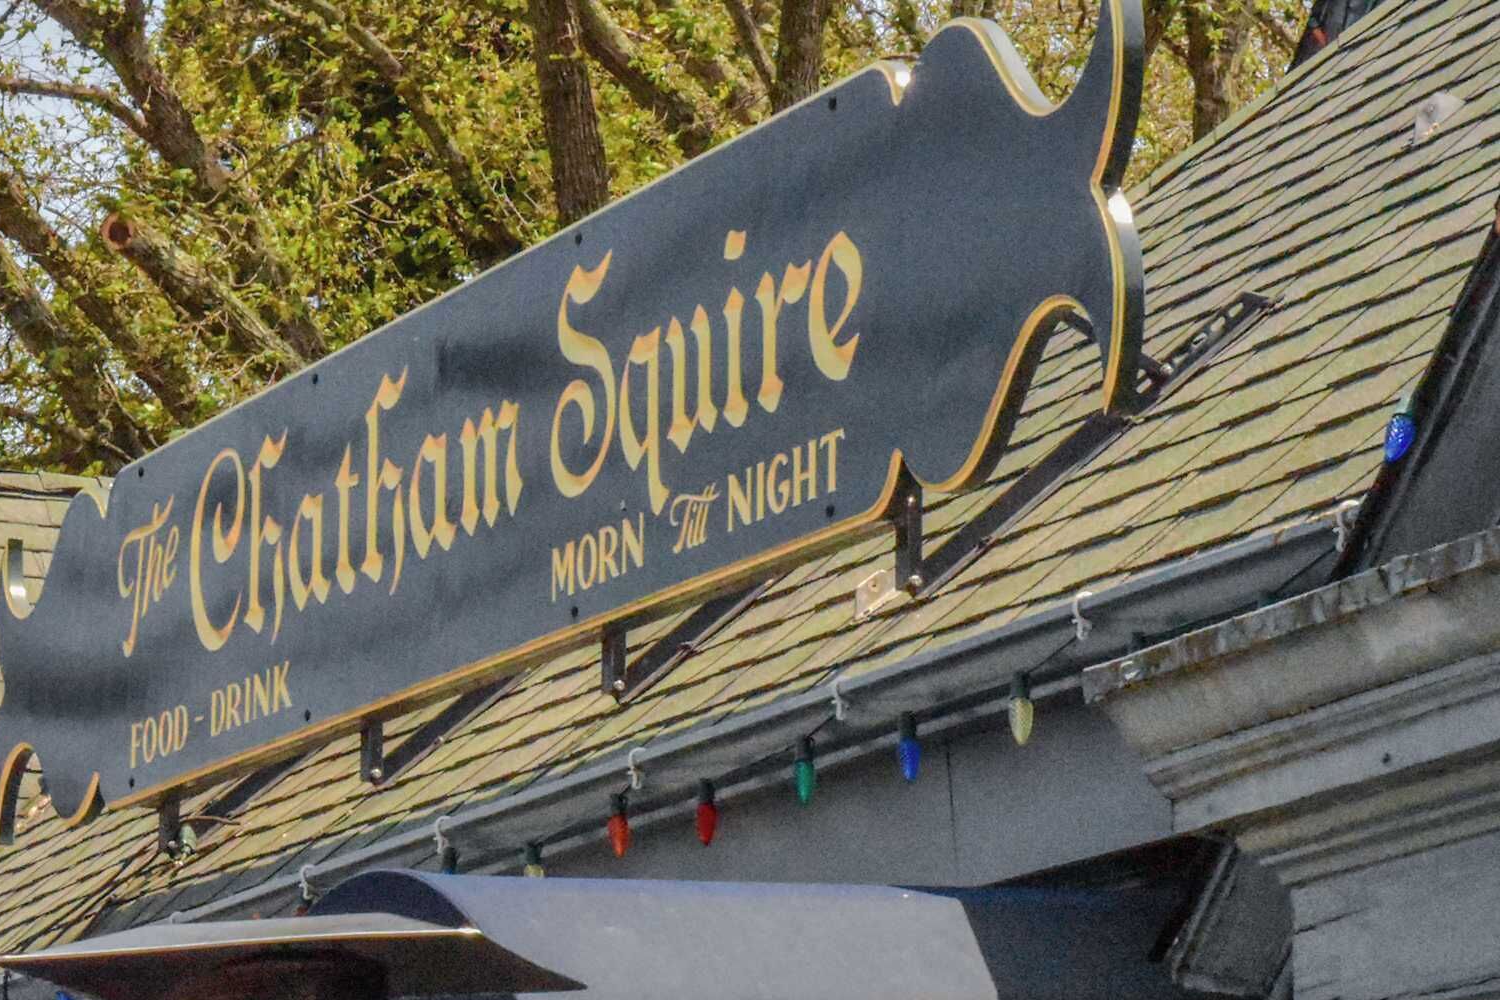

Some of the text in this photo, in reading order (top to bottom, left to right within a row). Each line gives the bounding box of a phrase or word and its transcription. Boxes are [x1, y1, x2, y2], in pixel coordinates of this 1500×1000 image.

[117, 230, 863, 658] The Chatham Squire
[551, 512, 644, 602] MORN
[727, 428, 845, 532] NIGHT
[210, 660, 292, 737] DRINK
